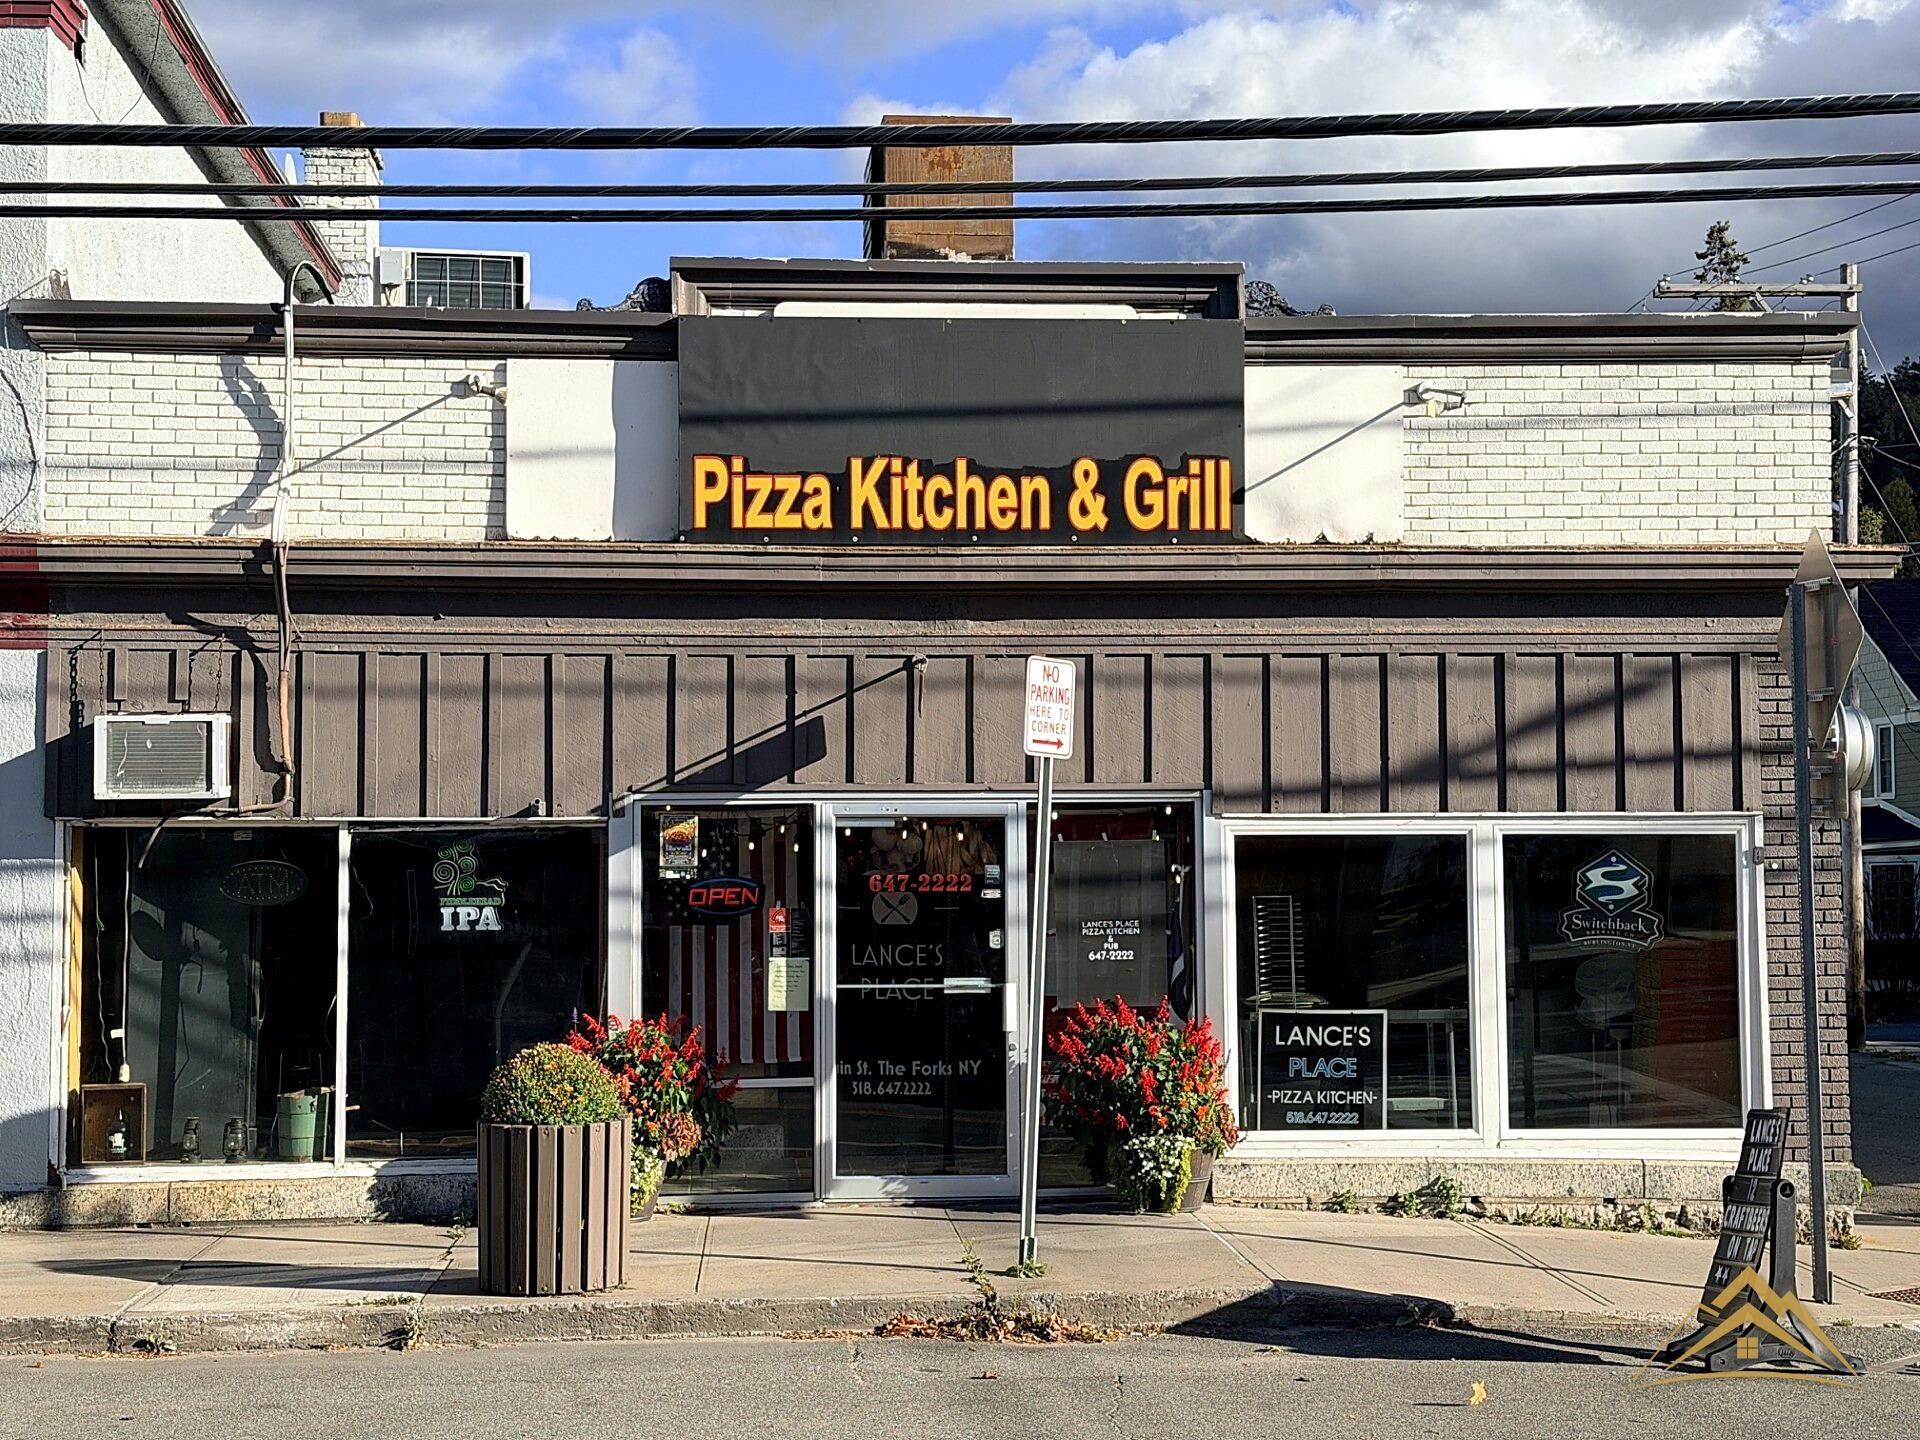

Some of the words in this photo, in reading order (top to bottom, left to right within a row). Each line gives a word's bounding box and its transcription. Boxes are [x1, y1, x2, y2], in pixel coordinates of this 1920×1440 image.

[692, 455, 833, 530] Pizza
[848, 455, 1052, 532] Kitchen
[1067, 455, 1109, 534] &
[1122, 455, 1233, 533] Grill
[1043, 665, 1060, 683] NO
[1030, 684, 1071, 706] PARKING
[1030, 705, 1052, 719] HERE
[1059, 708, 1070, 721] TO
[1031, 720, 1067, 735] CORNER
[237, 871, 289, 894] ATM
[868, 873, 973, 892] 647-2222
[688, 887, 759, 906] OPEN
[440, 906, 502, 931] IPA
[1115, 920, 1140, 928] PLACE
[1572, 914, 1650, 934] Switchback
[1082, 928, 1105, 936] PIZZA
[1106, 927, 1140, 935] KITCHEN
[852, 943, 943, 967] LANCE'S
[1088, 950, 1134, 961] 647-2222
[861, 978, 934, 1000] PLACE
[1275, 1025, 1371, 1047] LANCE'S
[837, 1060, 851, 1075] in
[856, 1060, 872, 1075] St.
[878, 1060, 906, 1076] The
[912, 1060, 952, 1076] Forks
[959, 1059, 982, 1075] NY
[1288, 1057, 1357, 1078] PLACE
[852, 1081, 932, 1095] 518.647.2222
[1286, 1111, 1359, 1124] 518.647.2222
[1747, 1148, 1772, 1172] PLACE
[1727, 1235, 1742, 1259] ON
